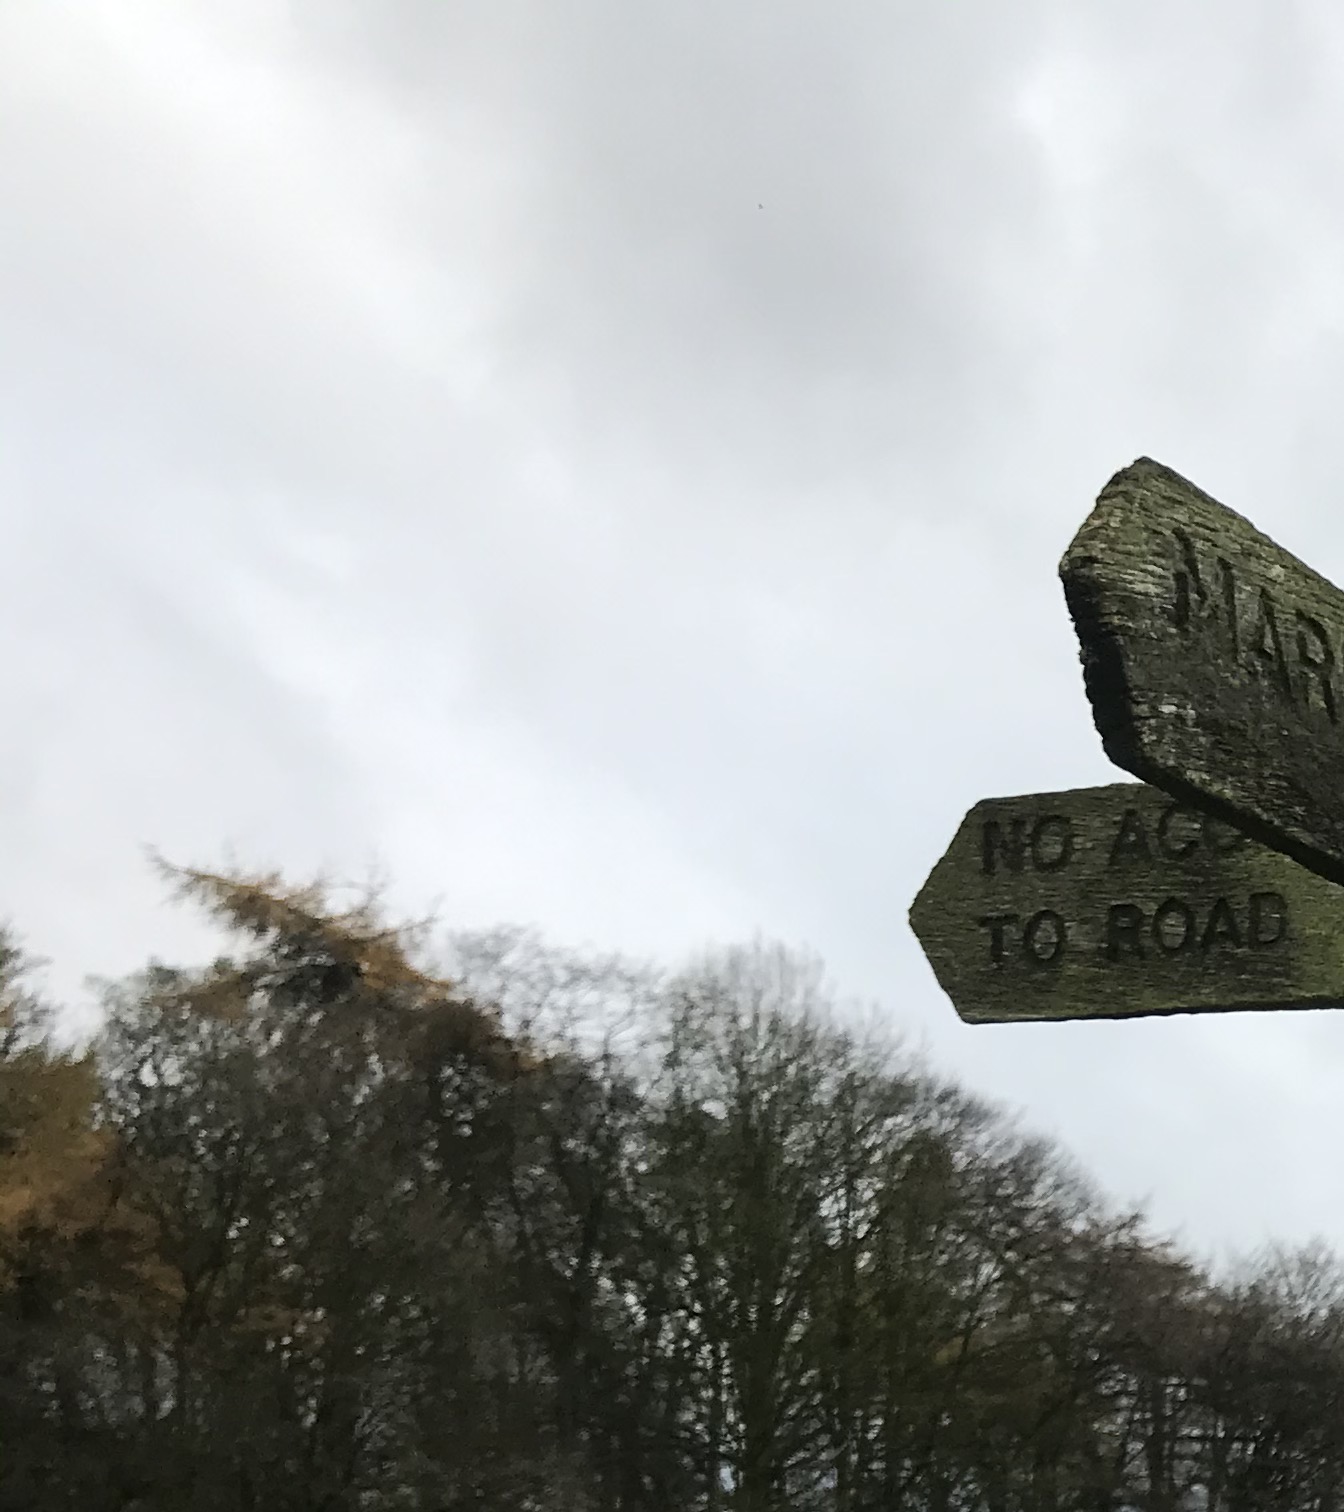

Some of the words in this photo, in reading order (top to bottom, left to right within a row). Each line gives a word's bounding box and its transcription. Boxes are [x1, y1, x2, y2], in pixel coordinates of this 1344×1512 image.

[981, 812, 1074, 874] NO
[980, 910, 1068, 964] TO
[1106, 892, 1288, 962] ROAD
